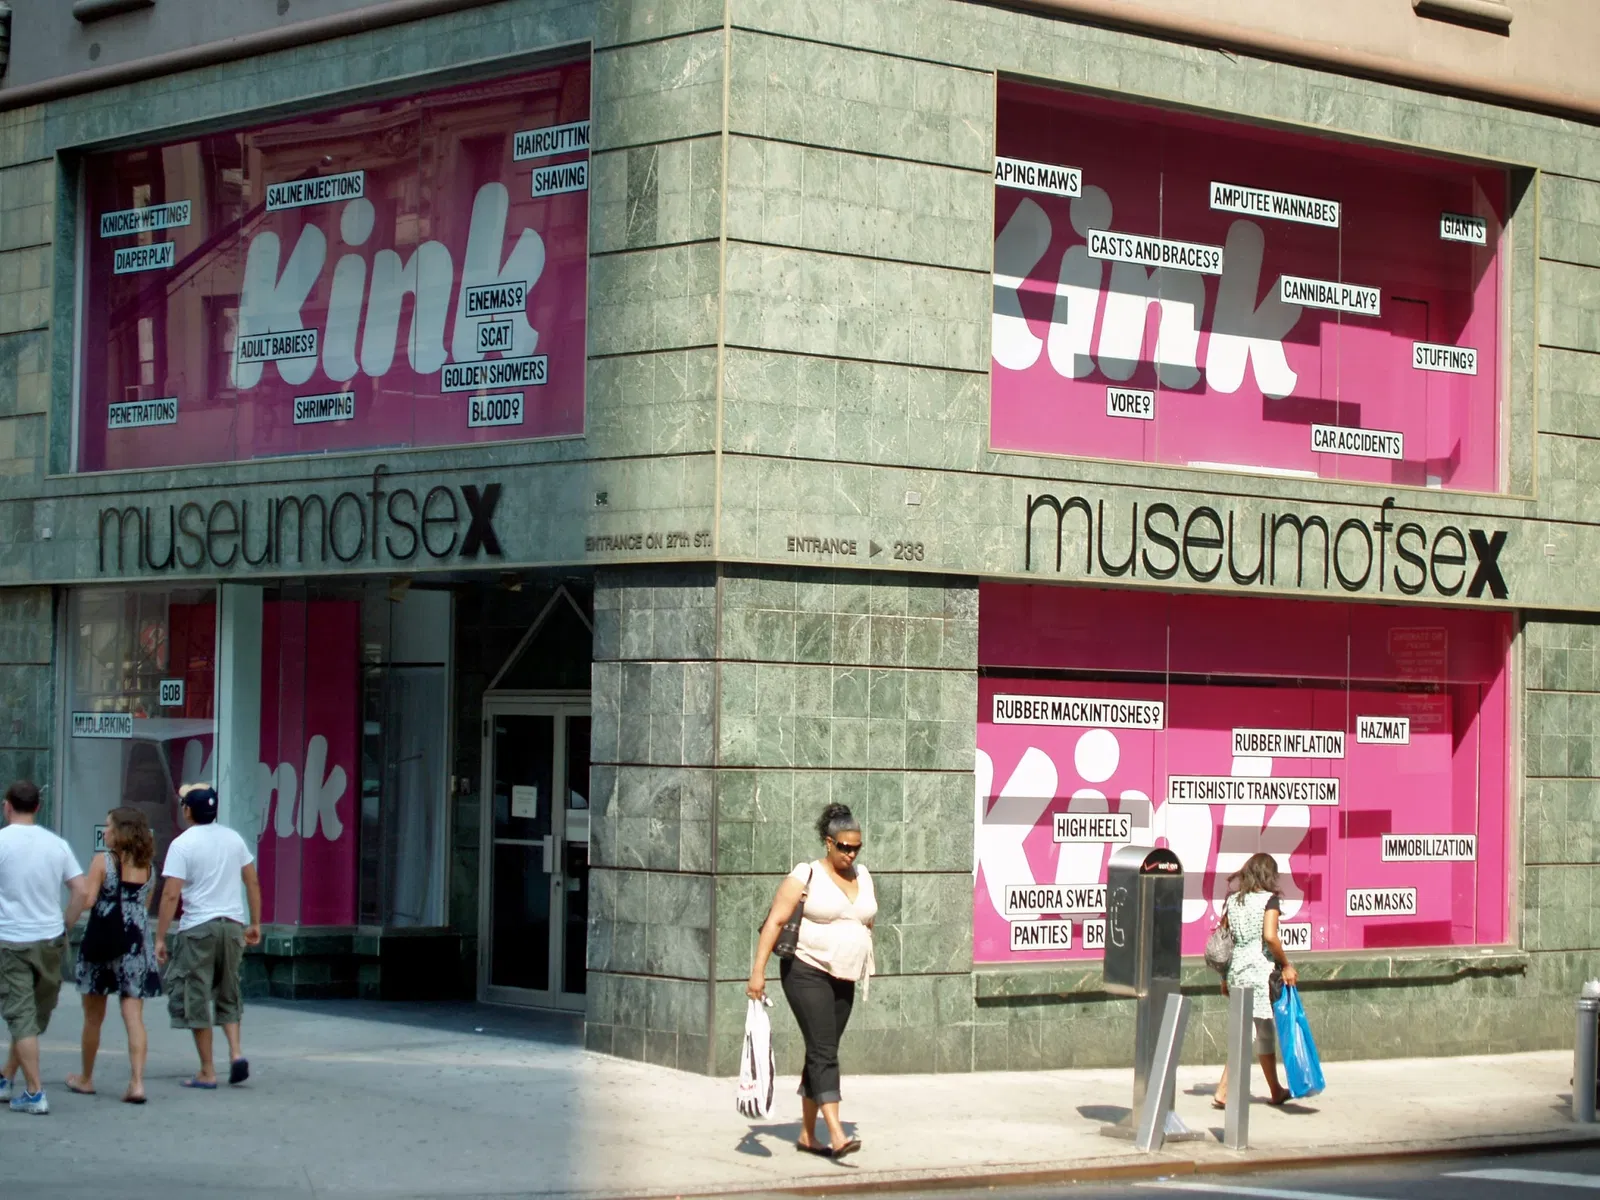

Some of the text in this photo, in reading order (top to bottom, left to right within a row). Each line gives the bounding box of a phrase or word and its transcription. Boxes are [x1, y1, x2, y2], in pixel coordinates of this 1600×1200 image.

[536, 166, 584, 192] SHAVING
[1038, 169, 1078, 192] MAWS
[268, 175, 361, 206] SALINE INJECTIONS
[1214, 187, 1336, 222] AMPUTEE WANNABES
[103, 205, 183, 234] KNICKER WETTING
[1444, 217, 1482, 238] GIANTS
[117, 246, 172, 270] DIAPER PLAY
[1092, 235, 1211, 268] CASTS AND BRACES
[469, 289, 514, 311] ENEMAS
[1284, 281, 1370, 308] CANNIBAL PLAY
[241, 335, 307, 359] ADULT BABIES
[481, 326, 510, 346] SCAT
[1416, 347, 1467, 368] STUFFING
[444, 361, 544, 388] GOLDEN SHOWERS
[110, 403, 174, 424] PENETRATIONS
[296, 398, 351, 420] SHRIMPING
[473, 400, 510, 421] BLOOD
[1111, 394, 1141, 413] VORE
[1314, 430, 1400, 454] CAR ACCIDENTS
[99, 464, 504, 572] museumofsex
[585, 533, 642, 552] ENTRANCE
[646, 532, 662, 550] ON
[694, 530, 712, 548] ST.
[787, 536, 925, 562] ENTRANCE 233
[1026, 497, 1508, 600] museumofsex
[162, 684, 180, 701] GOB
[997, 700, 1150, 724] RUBBER MACKINTOSHES
[74, 716, 130, 734] MUDLARKING
[1361, 721, 1406, 740] HAZMAT
[1236, 734, 1341, 754] RUBBER INFLATION
[1172, 780, 1336, 801] FETISHISTIC TRANSVESTISM
[1058, 818, 1128, 838] HIGH HEELS
[1385, 839, 1473, 856] IMMOBILIZATION
[1010, 890, 1063, 909] ANGORA
[1350, 892, 1413, 911] GAS MASKS
[1014, 924, 1068, 944] PANTIES
